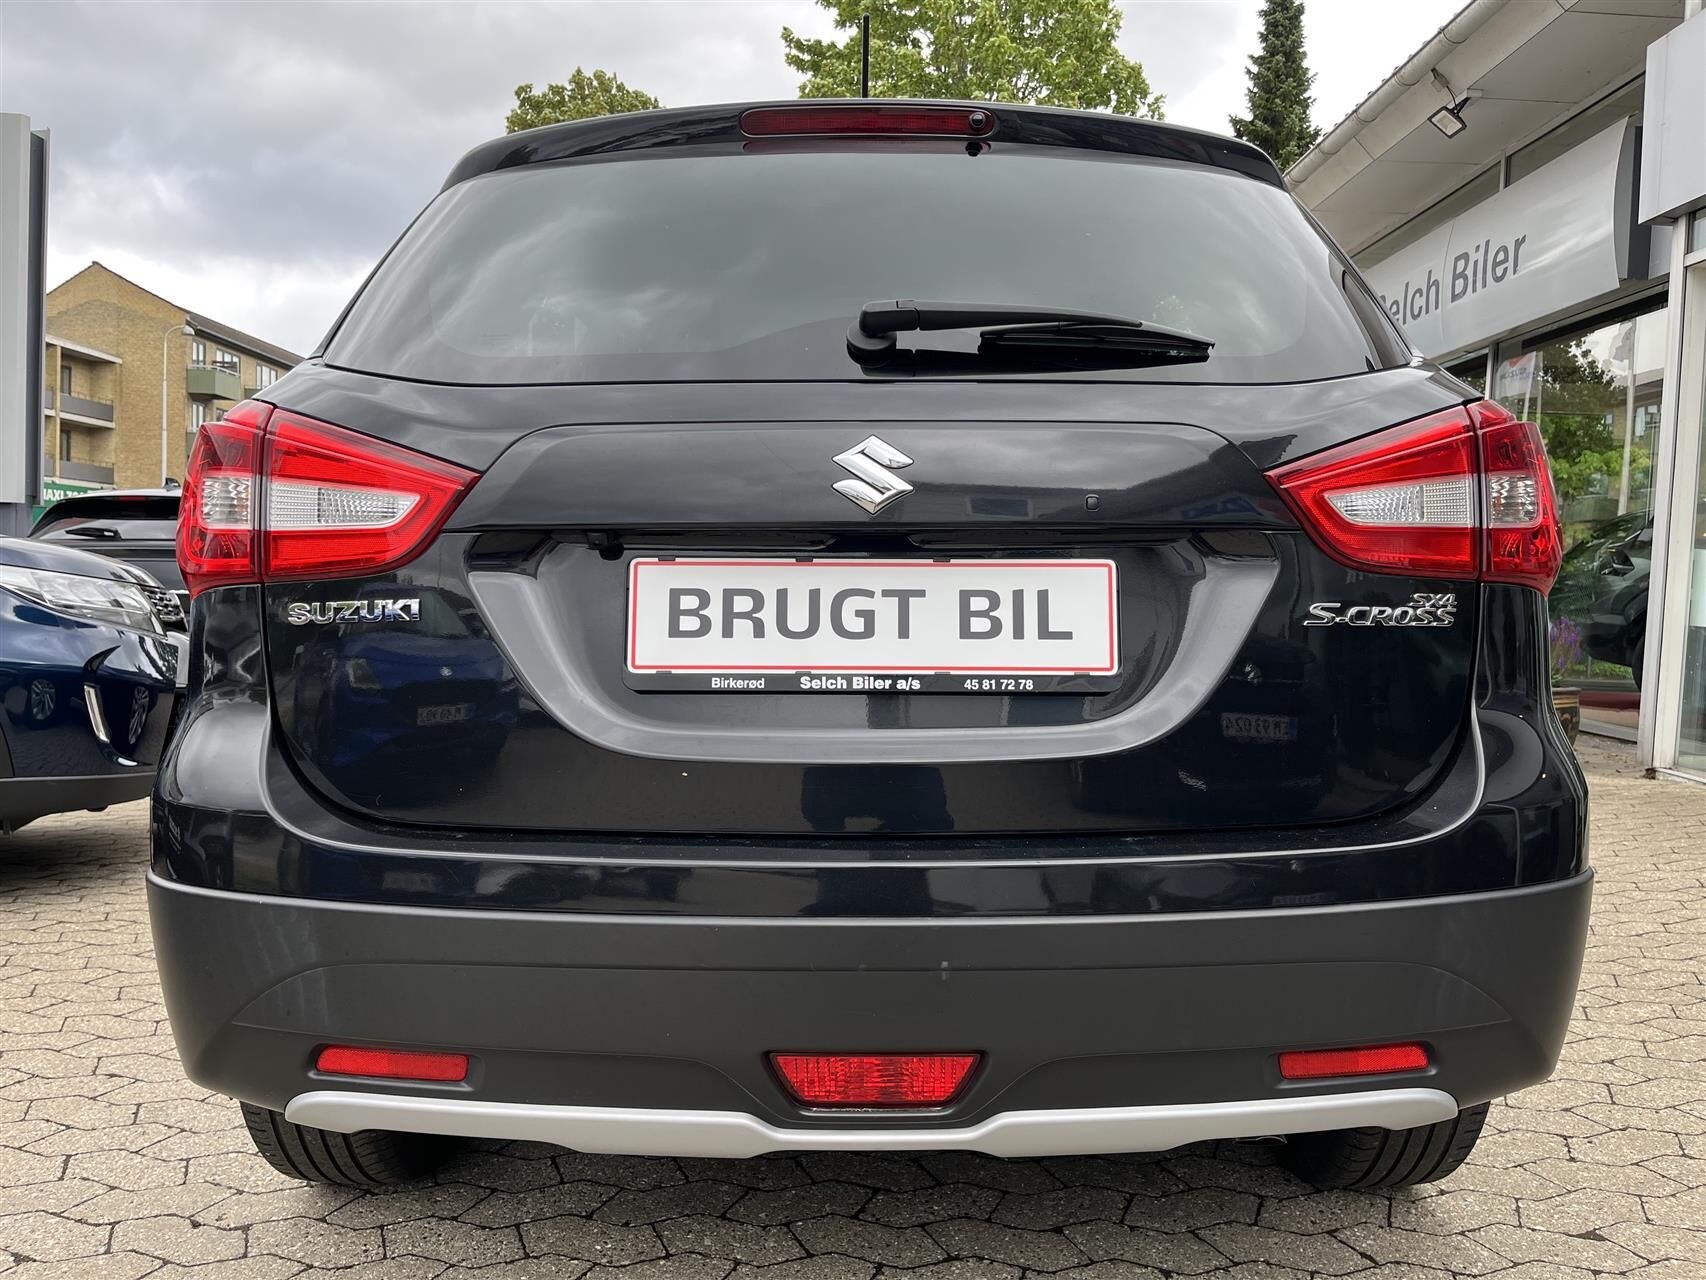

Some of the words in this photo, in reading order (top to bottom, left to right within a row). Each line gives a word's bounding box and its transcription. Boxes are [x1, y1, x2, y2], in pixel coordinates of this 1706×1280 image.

[1378, 269, 1440, 326] elch
[1450, 234, 1527, 304] Biler
[287, 598, 421, 626] SUZUKI
[1407, 593, 1458, 606] SX4
[667, 587, 927, 640] BRUGT
[958, 588, 1074, 641] BIL
[1303, 602, 1457, 627] S-CROSS
[711, 677, 765, 689] Birkerød
[799, 676, 847, 690] Selch
[852, 676, 892, 690] Biler
[896, 677, 921, 690] a/s
[963, 679, 979, 690] 45
[982, 679, 996, 690] 81
[1000, 679, 1015, 690] 72
[1018, 679, 1034, 690] 78
